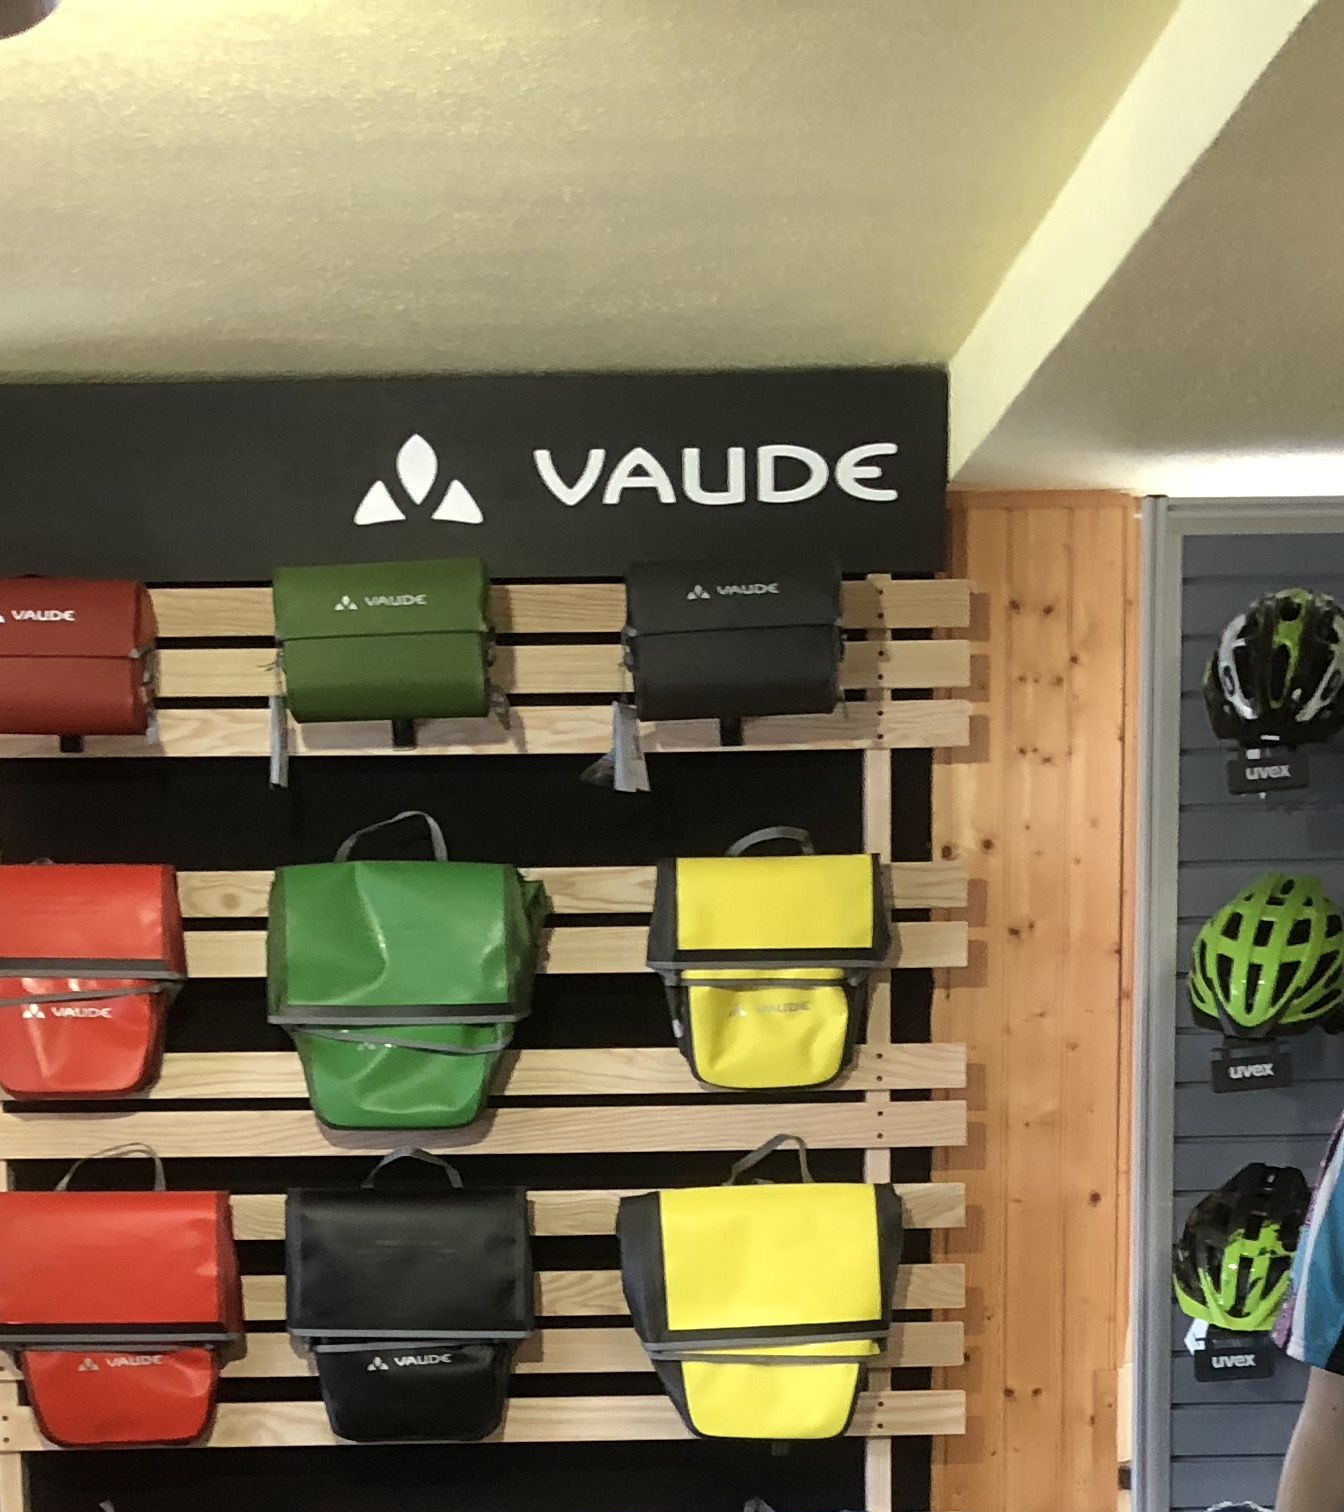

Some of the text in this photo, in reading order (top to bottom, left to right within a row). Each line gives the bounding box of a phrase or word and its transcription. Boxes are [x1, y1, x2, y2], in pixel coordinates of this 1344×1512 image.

[533, 442, 898, 506] VAUDE
[716, 582, 780, 595] VAUDE
[363, 593, 427, 607] VAUDE
[10, 609, 76, 622] VAUDE
[1245, 764, 1291, 780] uvex
[50, 1006, 113, 1019] VAUDE
[1229, 1063, 1275, 1079] uvex
[105, 1354, 164, 1367] VAUDE
[393, 1353, 453, 1367] VAUDE
[1211, 1353, 1257, 1368] uvex
